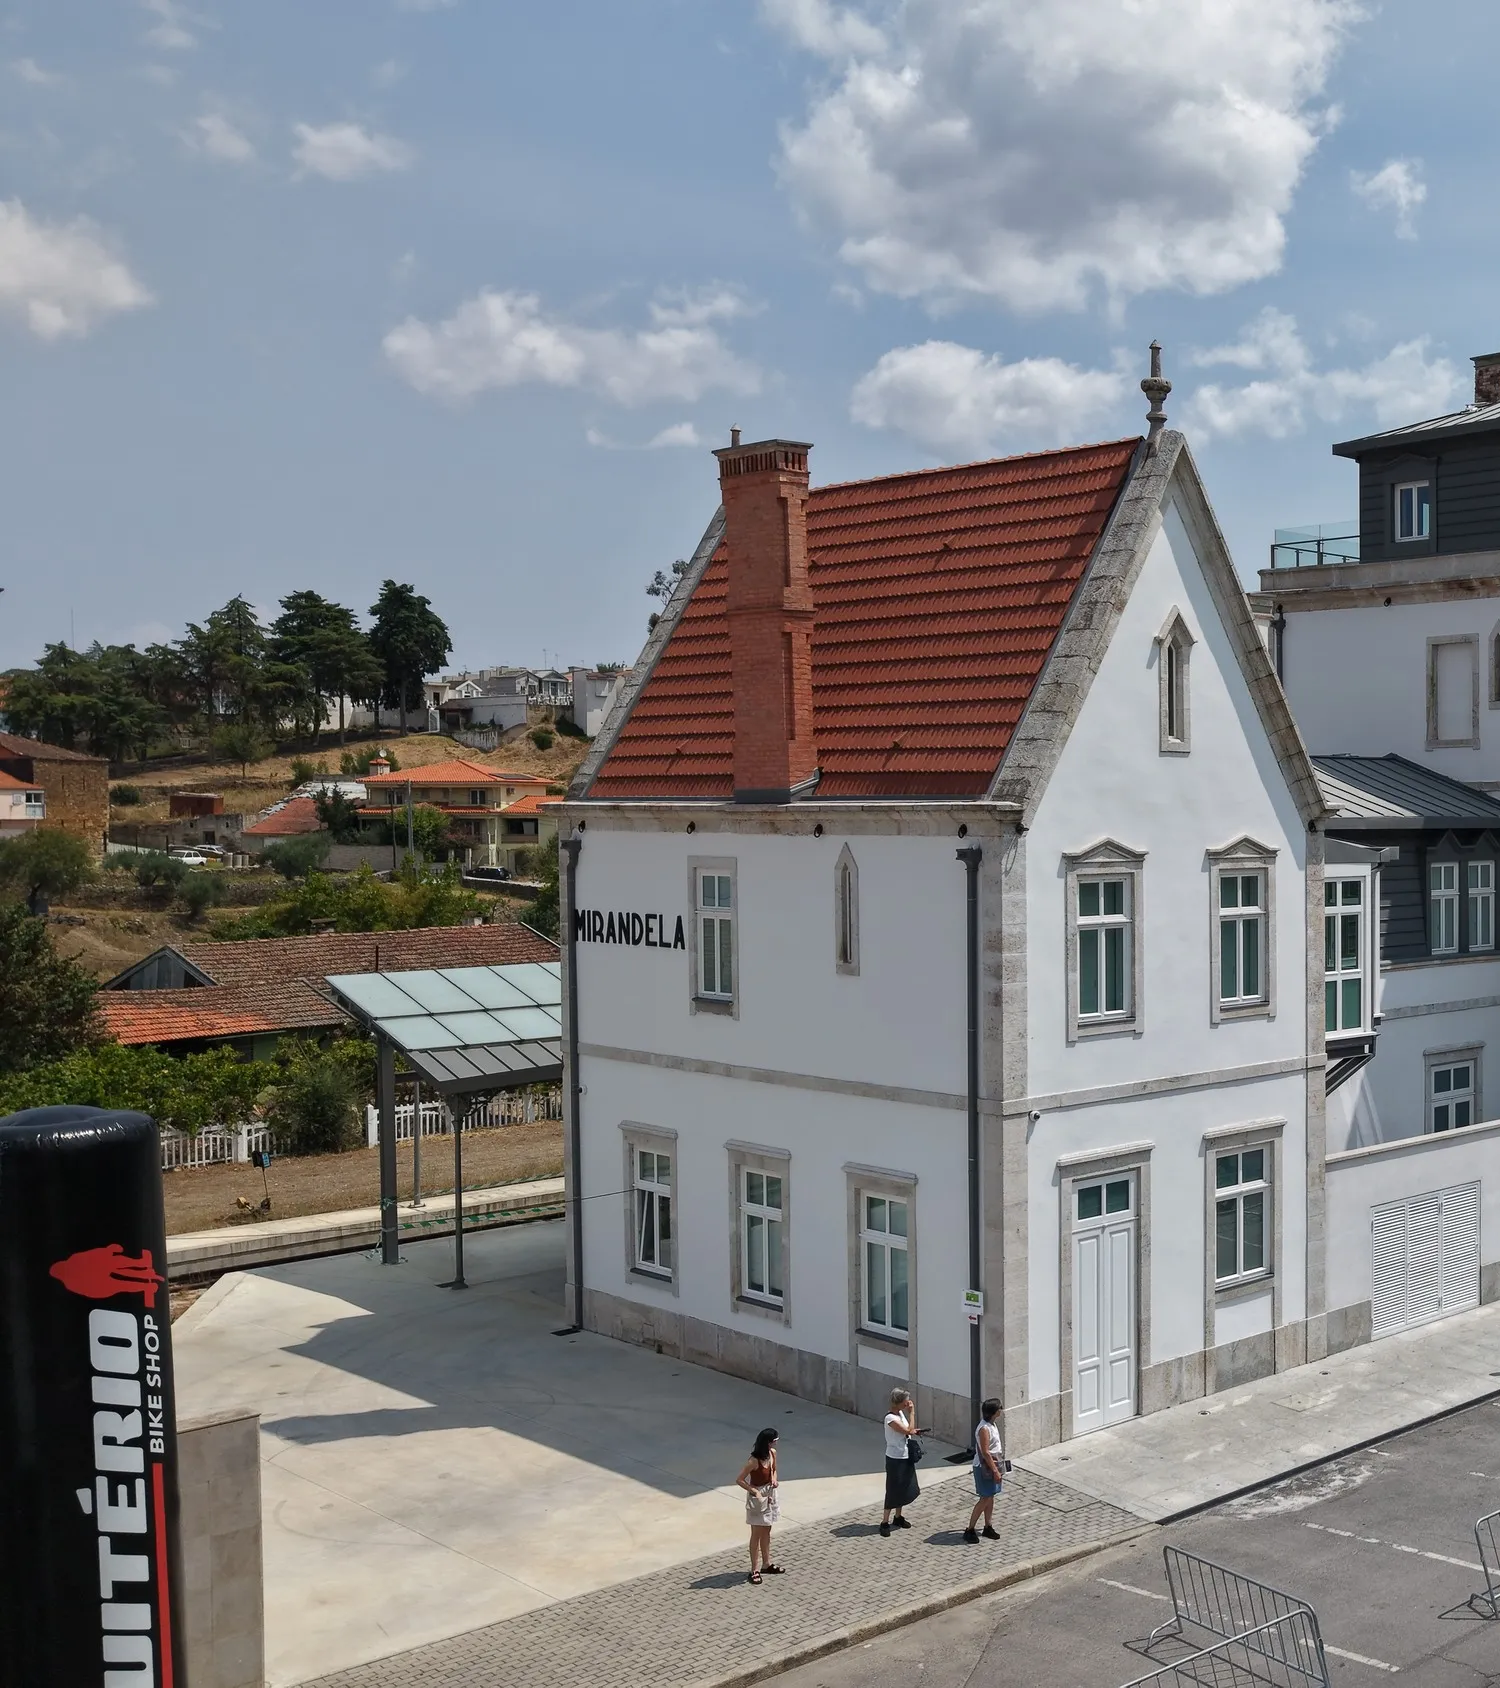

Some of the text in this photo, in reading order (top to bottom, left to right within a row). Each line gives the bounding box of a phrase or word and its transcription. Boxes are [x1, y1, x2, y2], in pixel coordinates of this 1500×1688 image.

[575, 909, 686, 951] MIRANDELA
[144, 1314, 165, 1455] BIKE SHOP
